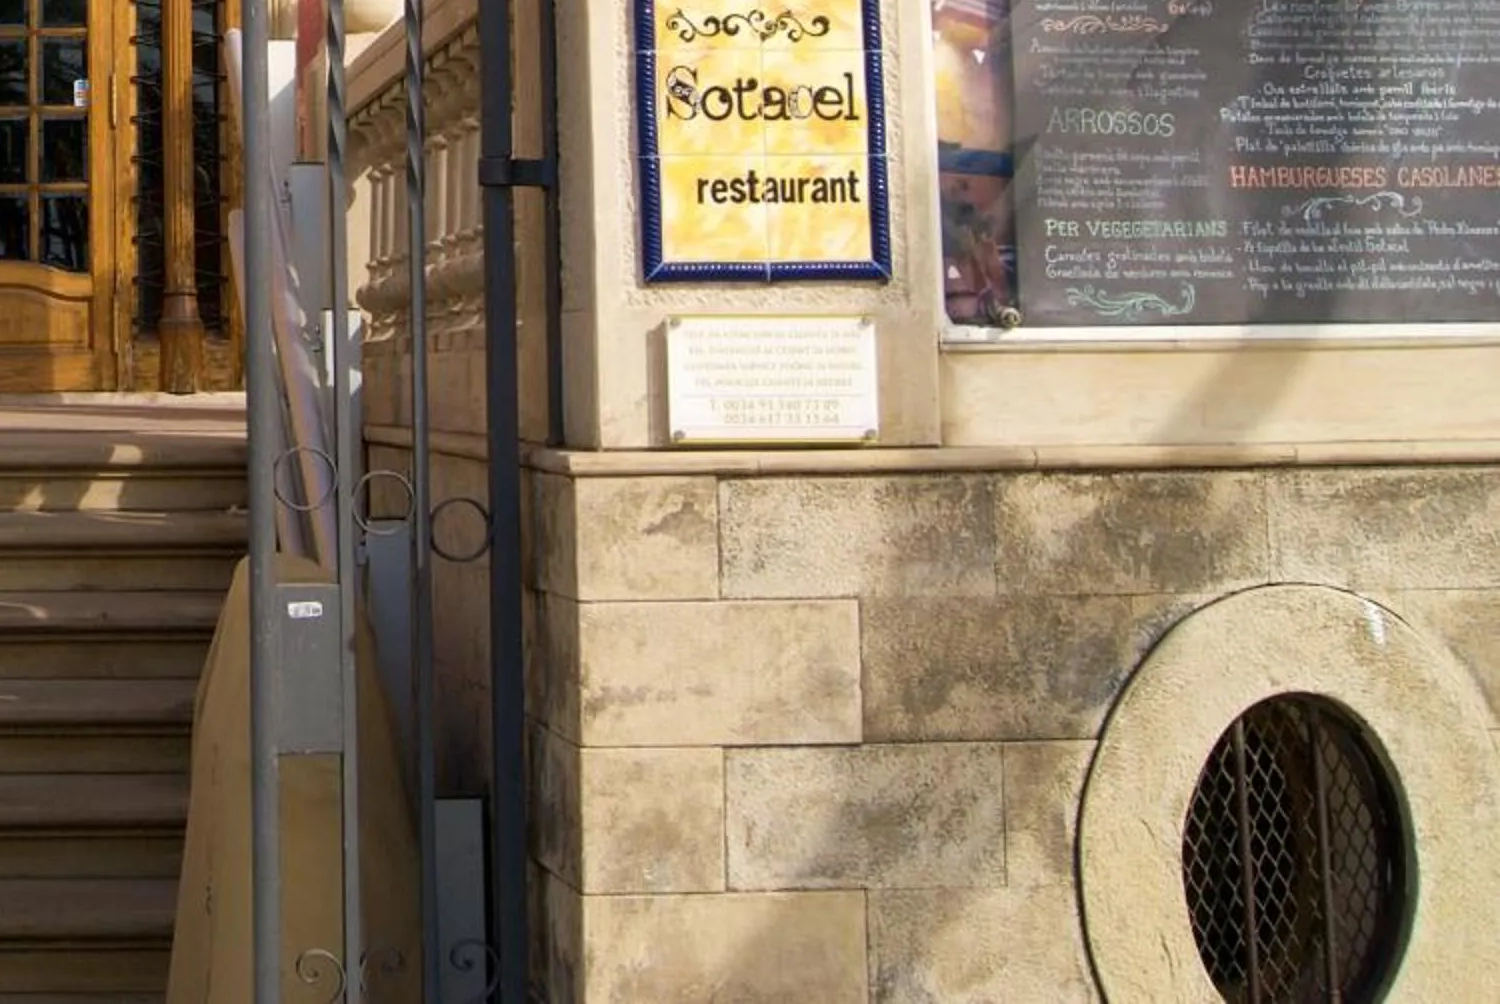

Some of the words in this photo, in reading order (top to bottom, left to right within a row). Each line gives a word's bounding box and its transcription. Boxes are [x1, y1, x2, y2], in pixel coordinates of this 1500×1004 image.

[666, 65, 860, 121] Sotacel
[1046, 108, 1176, 137] ARROSSOS
[696, 169, 861, 204] restaurant
[1229, 165, 1387, 188] HAMBURGUESES
[1044, 217, 1080, 238] PER
